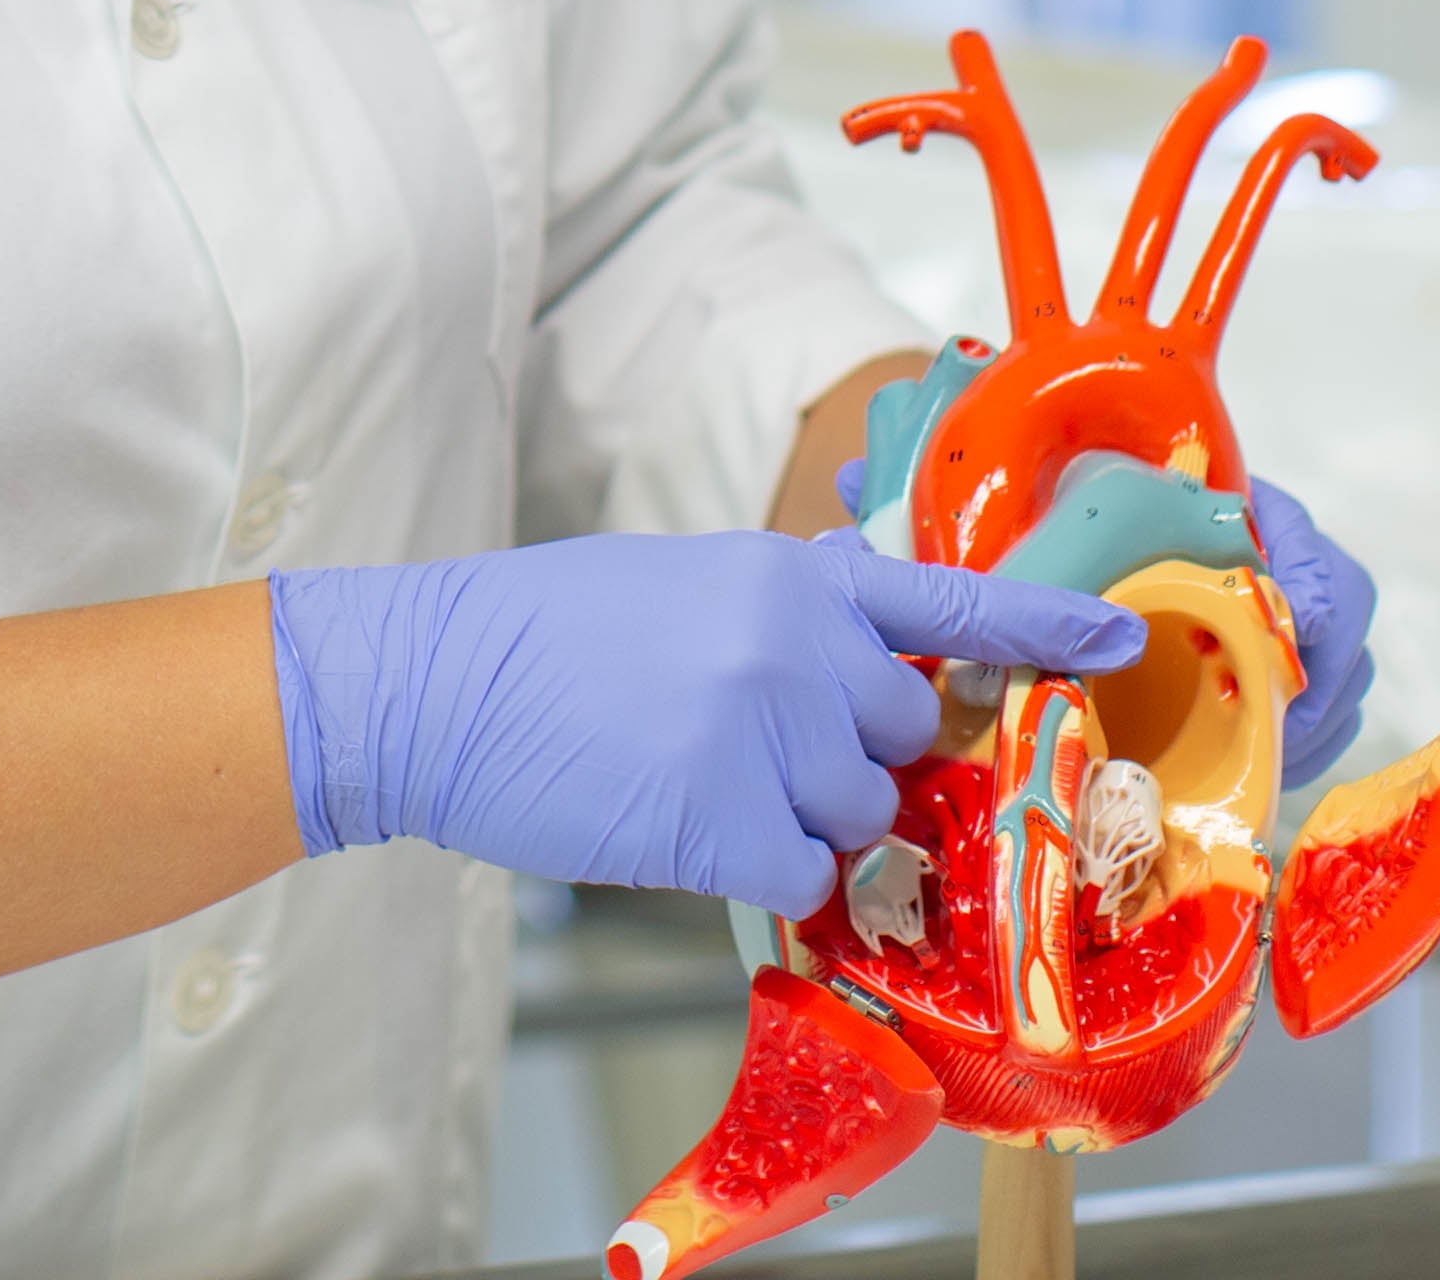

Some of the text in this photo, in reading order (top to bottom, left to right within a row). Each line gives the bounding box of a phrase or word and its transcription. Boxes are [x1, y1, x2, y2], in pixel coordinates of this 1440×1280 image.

[1034, 302, 1056, 318] 13
[1159, 347, 1176, 359] 12
[949, 449, 963, 463] 11
[1085, 506, 1099, 520] 9
[1223, 575, 1237, 588] 8
